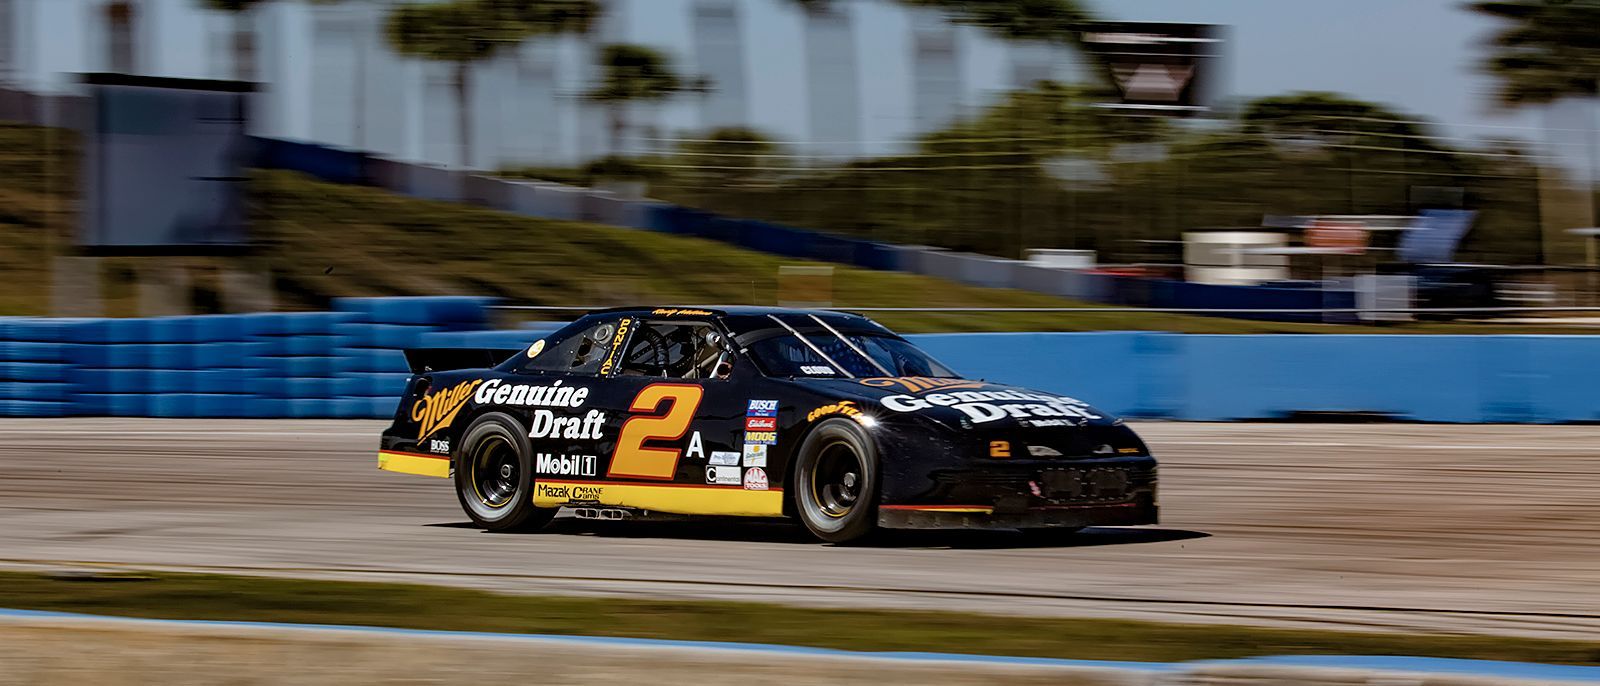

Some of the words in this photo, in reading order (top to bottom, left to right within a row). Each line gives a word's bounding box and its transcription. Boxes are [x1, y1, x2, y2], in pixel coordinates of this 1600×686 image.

[600, 318, 631, 375] PONTIAC
[474, 378, 589, 408] Genuine
[749, 399, 778, 410] BUSCH
[880, 390, 1090, 412] Genuine
[412, 379, 483, 441] Miller
[807, 400, 864, 426] GOODYE
[952, 402, 1102, 423] Draft
[528, 409, 606, 440] Draft
[606, 382, 705, 481] 2
[430, 439, 449, 451] BOSS
[686, 430, 705, 459] A
[745, 431, 777, 442] MOOG
[990, 441, 1011, 457] 2
[536, 453, 580, 476] Mobil
[538, 484, 570, 498] Mazak
